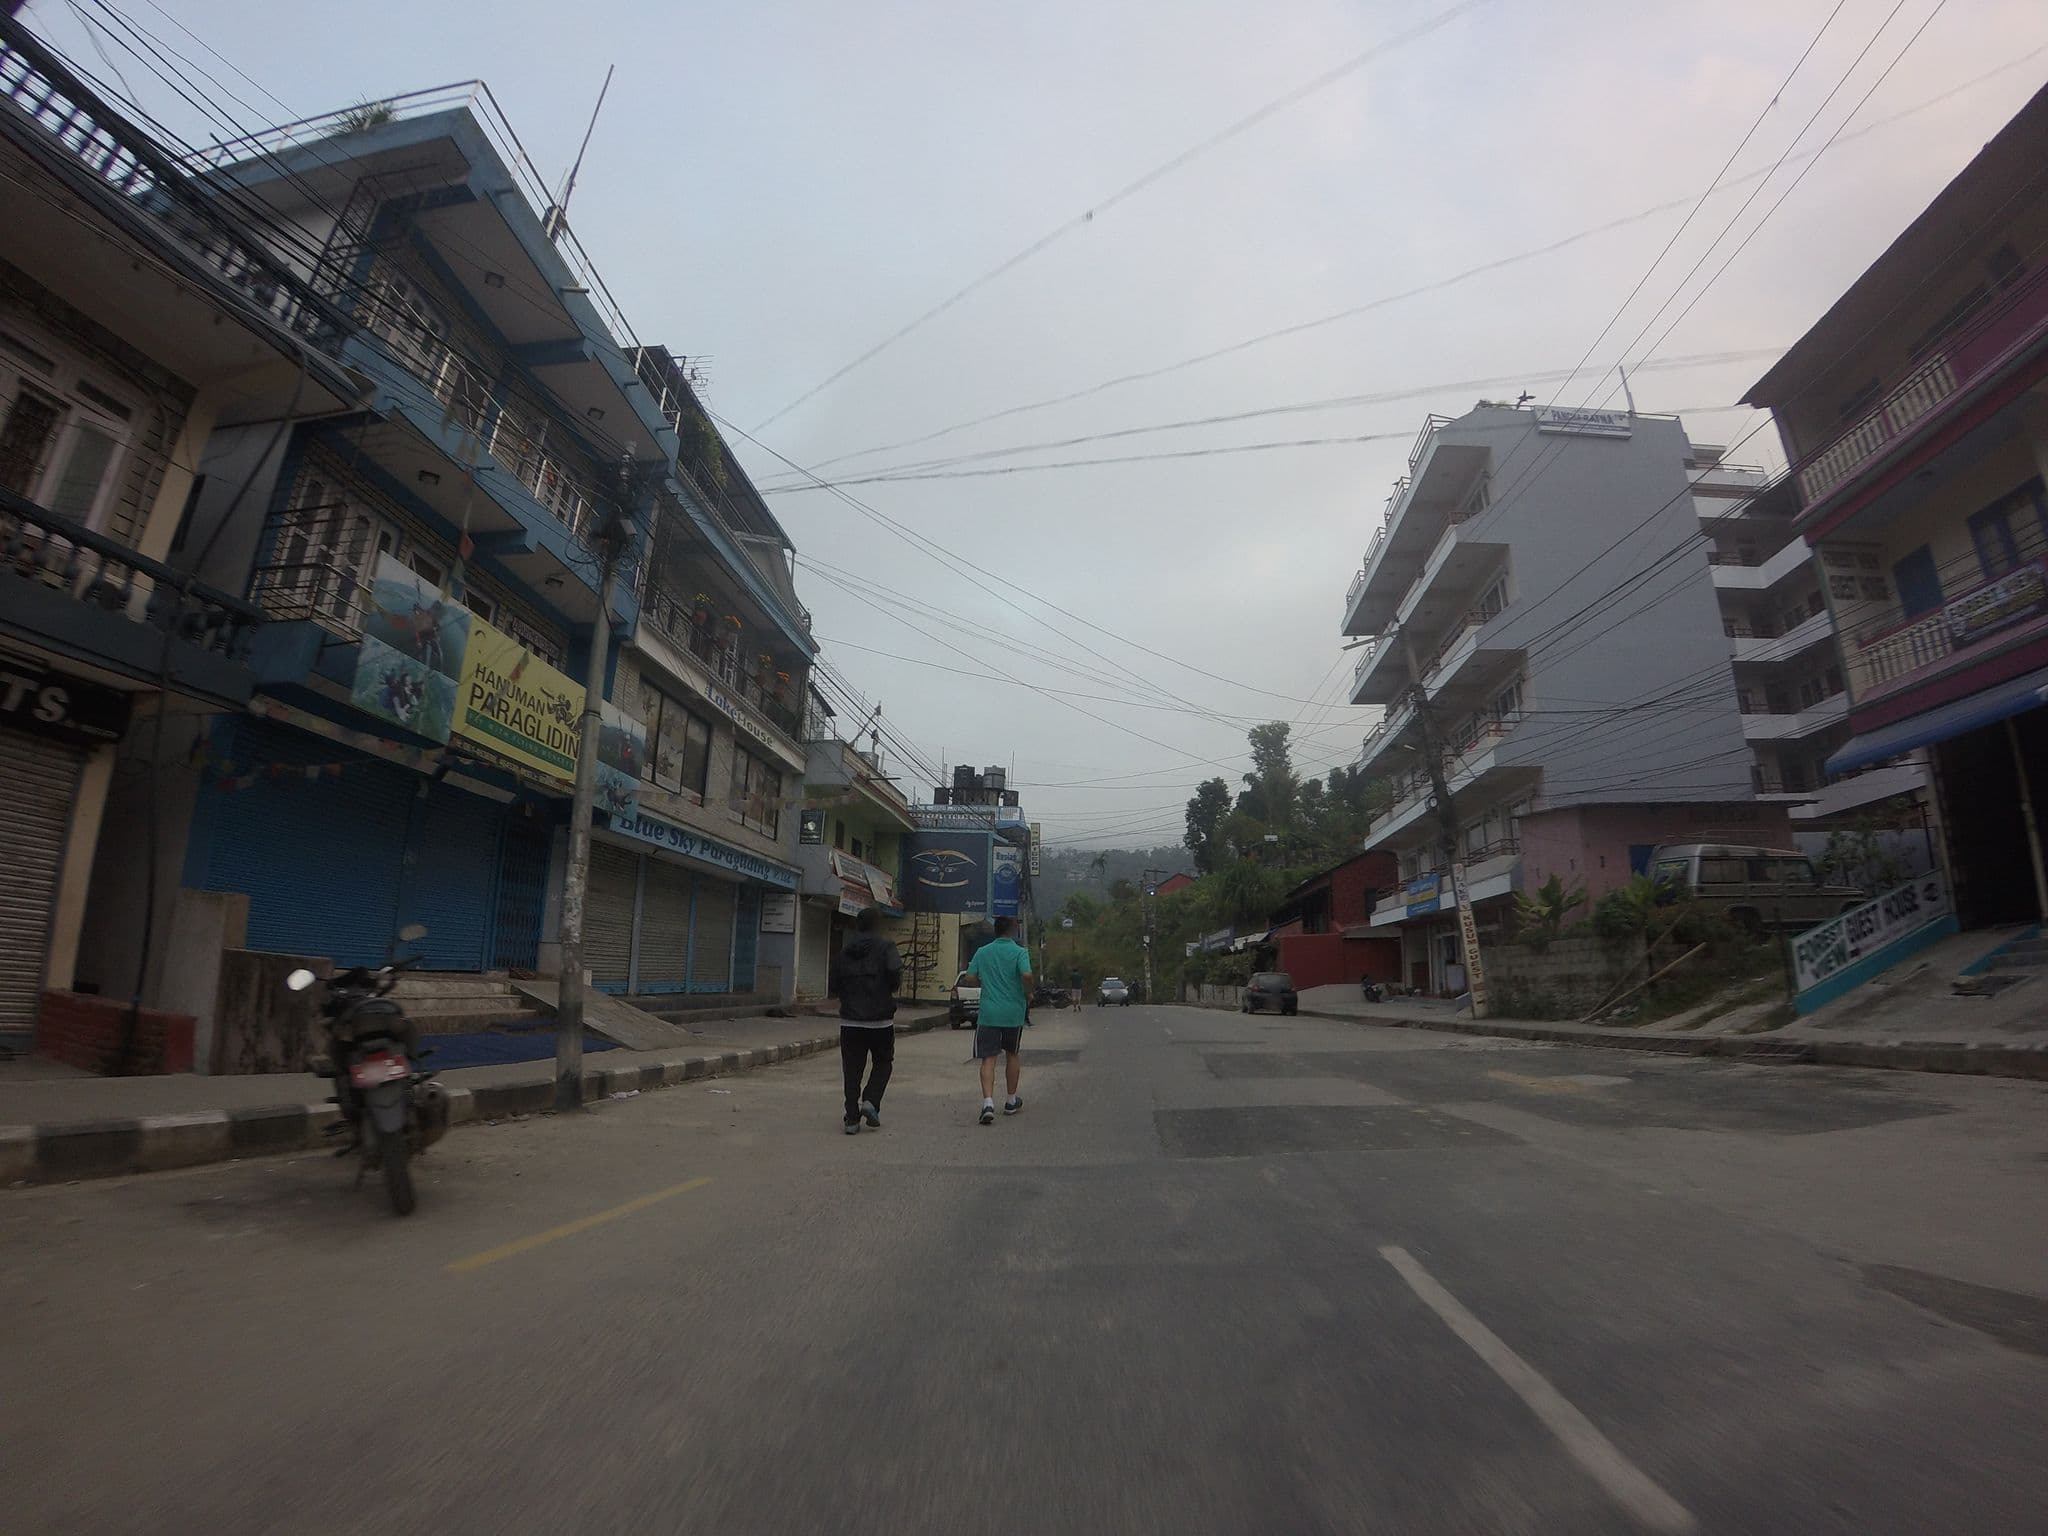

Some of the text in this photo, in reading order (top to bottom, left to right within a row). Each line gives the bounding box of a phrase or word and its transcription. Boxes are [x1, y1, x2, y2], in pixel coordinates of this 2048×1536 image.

[475, 662, 546, 716] HANUMAN
[469, 683, 579, 759] PARAGLIDIN
[668, 826, 697, 855] Sky
[699, 839, 771, 881] Paragliding
